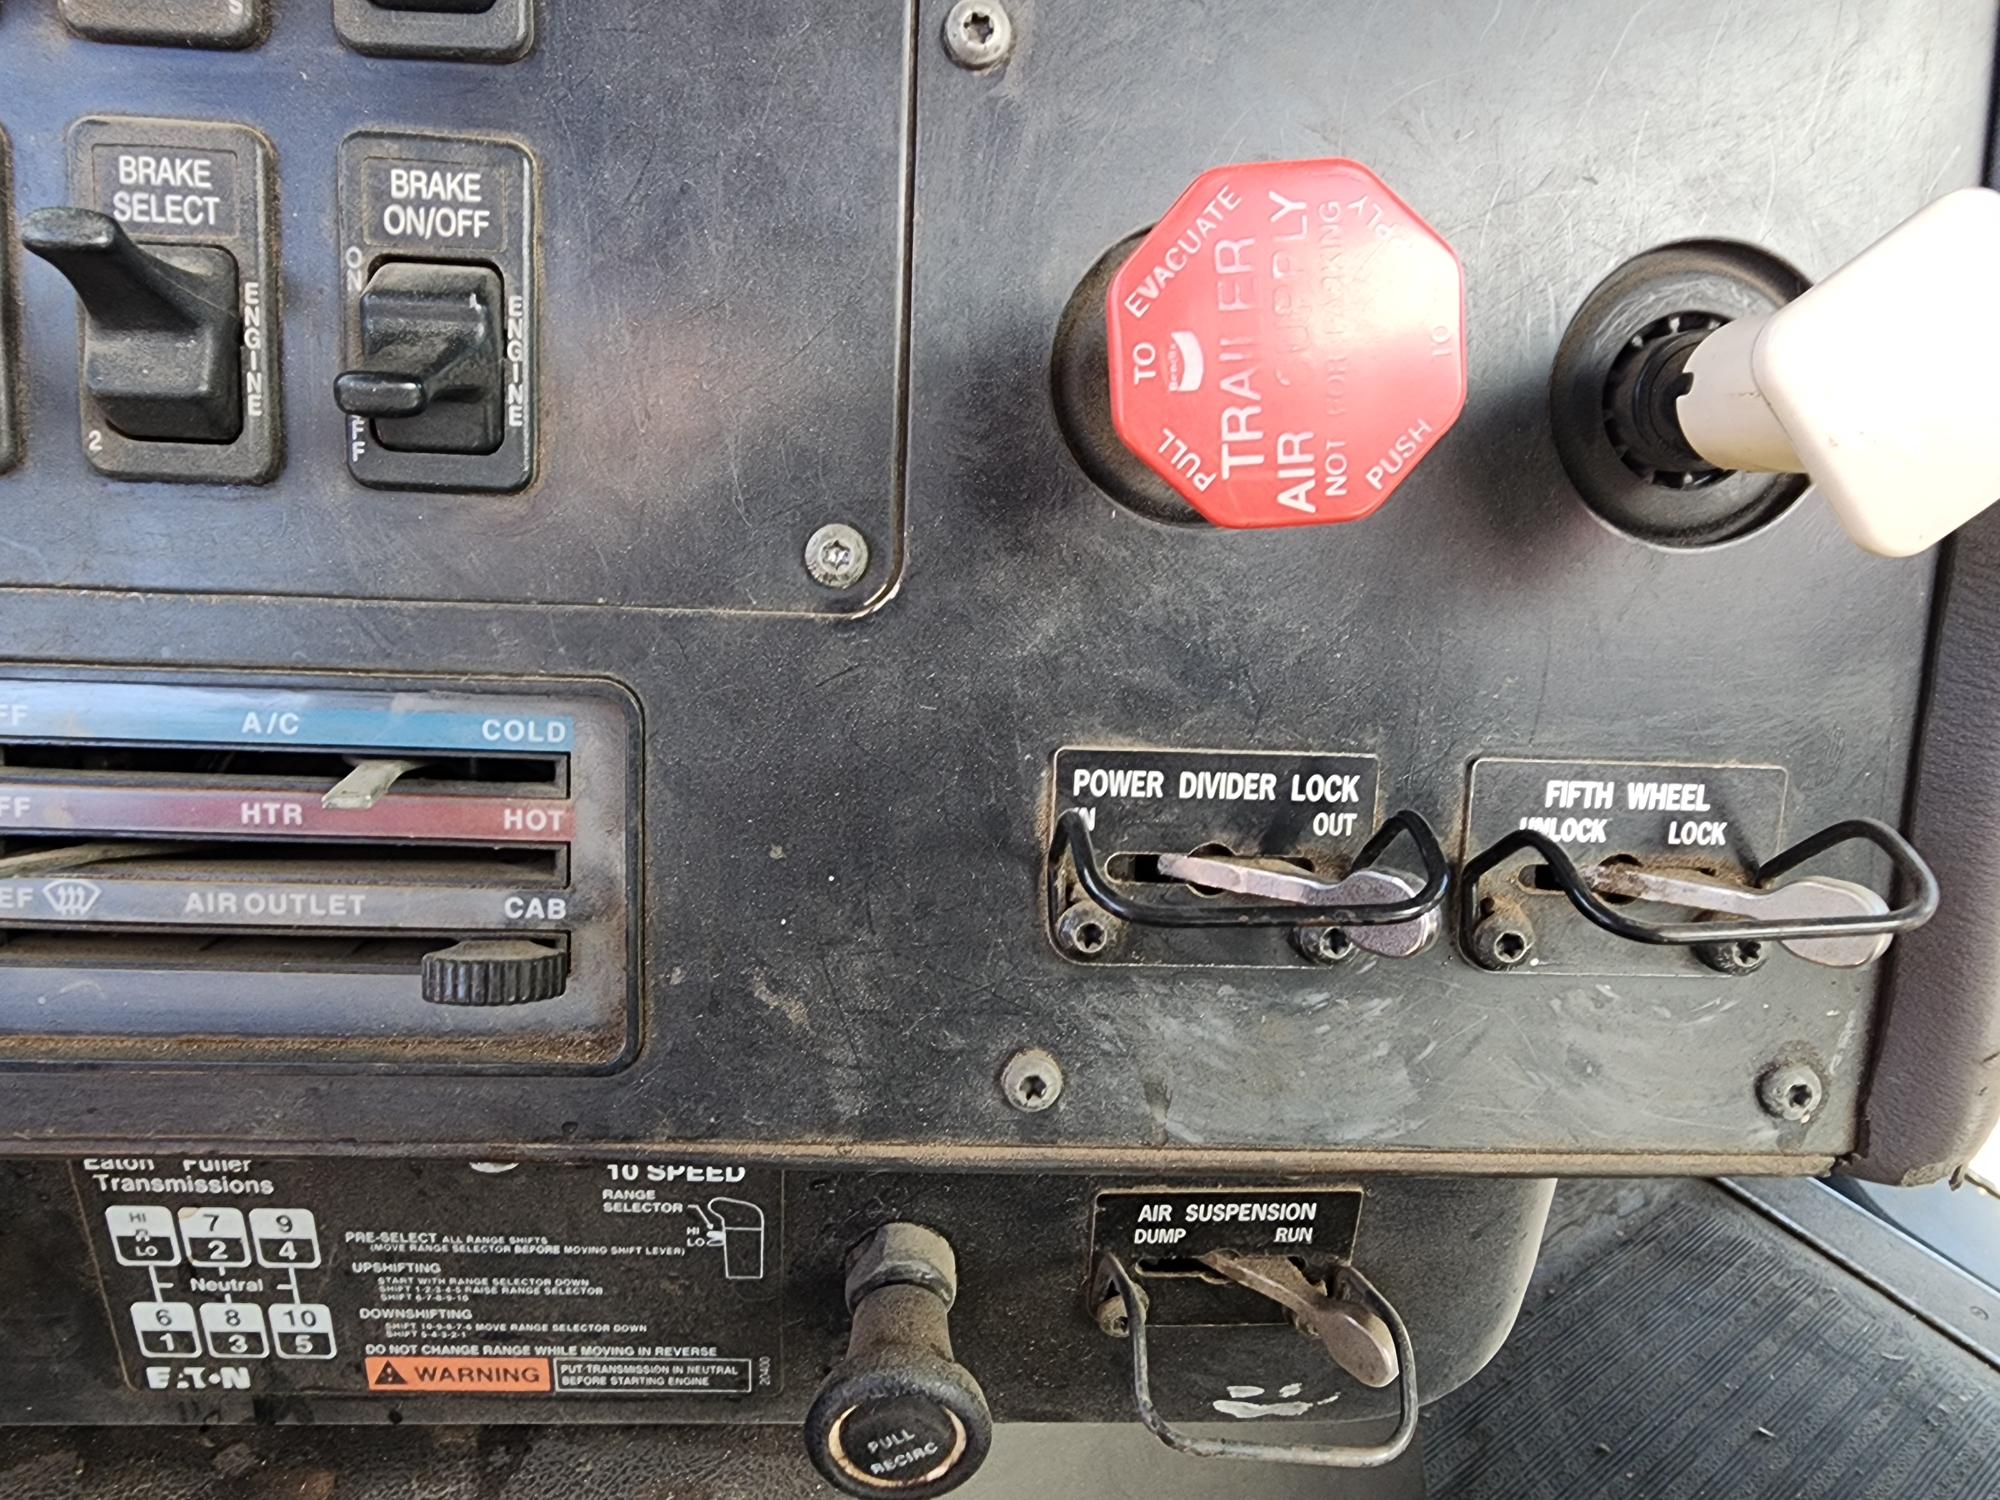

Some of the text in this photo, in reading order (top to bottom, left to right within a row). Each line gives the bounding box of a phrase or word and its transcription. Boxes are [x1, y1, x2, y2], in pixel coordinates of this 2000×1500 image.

[118, 157, 212, 189] BRAKE
[390, 170, 482, 203] BRAKE
[113, 193, 220, 226] SELECT
[383, 207, 490, 239] ON/OFF
[345, 247, 363, 291] ON
[1124, 185, 1242, 492] PULL TO EVACUATE
[245, 281, 261, 417] ENGINE
[1214, 237, 1265, 480] TRAILER
[508, 295, 523, 427] ENGINE
[88, 431, 102, 452] 2
[351, 415, 366, 462] FF
[1364, 418, 1434, 490] PUSH
[1277, 431, 1317, 514] AIR
[1325, 440, 1348, 497] NOT
[241, 711, 299, 735] A/C
[482, 719, 566, 743] COLD
[1072, 768, 1360, 803] POWER DIVIDER LOCK
[1545, 780, 1711, 812] FIFTH WHEEL
[240, 803, 303, 825] HTR
[503, 809, 564, 831] HOT
[1073, 806, 1097, 832] N
[1313, 812, 1358, 837] OUT
[1667, 821, 1728, 845] LOCK
[185, 892, 366, 916] AIR OUTLET
[504, 897, 566, 920] CAB
[83, 1158, 155, 1171] Eaton
[607, 1164, 746, 1182] 10 SPEED
[92, 1174, 275, 1195] Transmissions
[602, 1189, 656, 1200] RANGE
[603, 1202, 683, 1213] SELECTOR
[1137, 1202, 1317, 1222] AIR SUSPENSION
[129, 1213, 147, 1223] HI
[203, 1214, 220, 1231] 7
[275, 1215, 293, 1233] 9
[345, 1231, 548, 1245] PRE-SELECT ALL RANGE SHIFTS
[687, 1226, 700, 1235] HI
[1134, 1228, 1186, 1244] DUMP
[1274, 1227, 1314, 1243] RUN
[135, 1245, 158, 1256] LO
[207, 1241, 228, 1260] 2
[279, 1241, 297, 1261] 4
[409, 1244, 448, 1252] RANGE
[452, 1244, 511, 1253] SELECTOR
[514, 1245, 560, 1255] BEFORE
[564, 1245, 608, 1255] MOVING
[611, 1246, 641, 1255] SHIFT
[645, 1246, 686, 1256] LEVER)
[687, 1237, 705, 1247] LO
[352, 1262, 441, 1273] UPSHIFTING
[190, 1277, 264, 1292] Neutral
[377, 1277, 589, 1287] START WITH RANGE SELECTOR DOWN
[379, 1285, 410, 1294] SHIFT
[464, 1286, 498, 1295] RAISE
[501, 1286, 540, 1295] RANGE
[544, 1287, 603, 1296] SELECTOR
[381, 1293, 412, 1302] SHIFT
[155, 1309, 172, 1326] 6
[225, 1309, 242, 1327] 8
[283, 1310, 317, 1328] 10
[359, 1308, 473, 1319] DOWNSHIFTING
[385, 1322, 416, 1330] SHIFT
[475, 1323, 507, 1332] MOVE
[510, 1323, 548, 1332] RANGE
[552, 1324, 610, 1333] SELECTOR
[613, 1324, 647, 1333] DOWN
[159, 1333, 175, 1351] 1
[228, 1334, 248, 1353] 3
[295, 1335, 313, 1354] 5
[365, 1344, 717, 1357] DO NOT CHANGE RANGE WHILE MOVING IN REVERSE
[414, 1366, 540, 1383] WARNING
[561, 1364, 738, 1375] PUT TRANSMISSION IN NEUTRAL
[562, 1375, 709, 1386] BEFORE STARTING ENGINE
[867, 1429, 915, 1454] PULL
[870, 1441, 938, 1475] RECIRC
